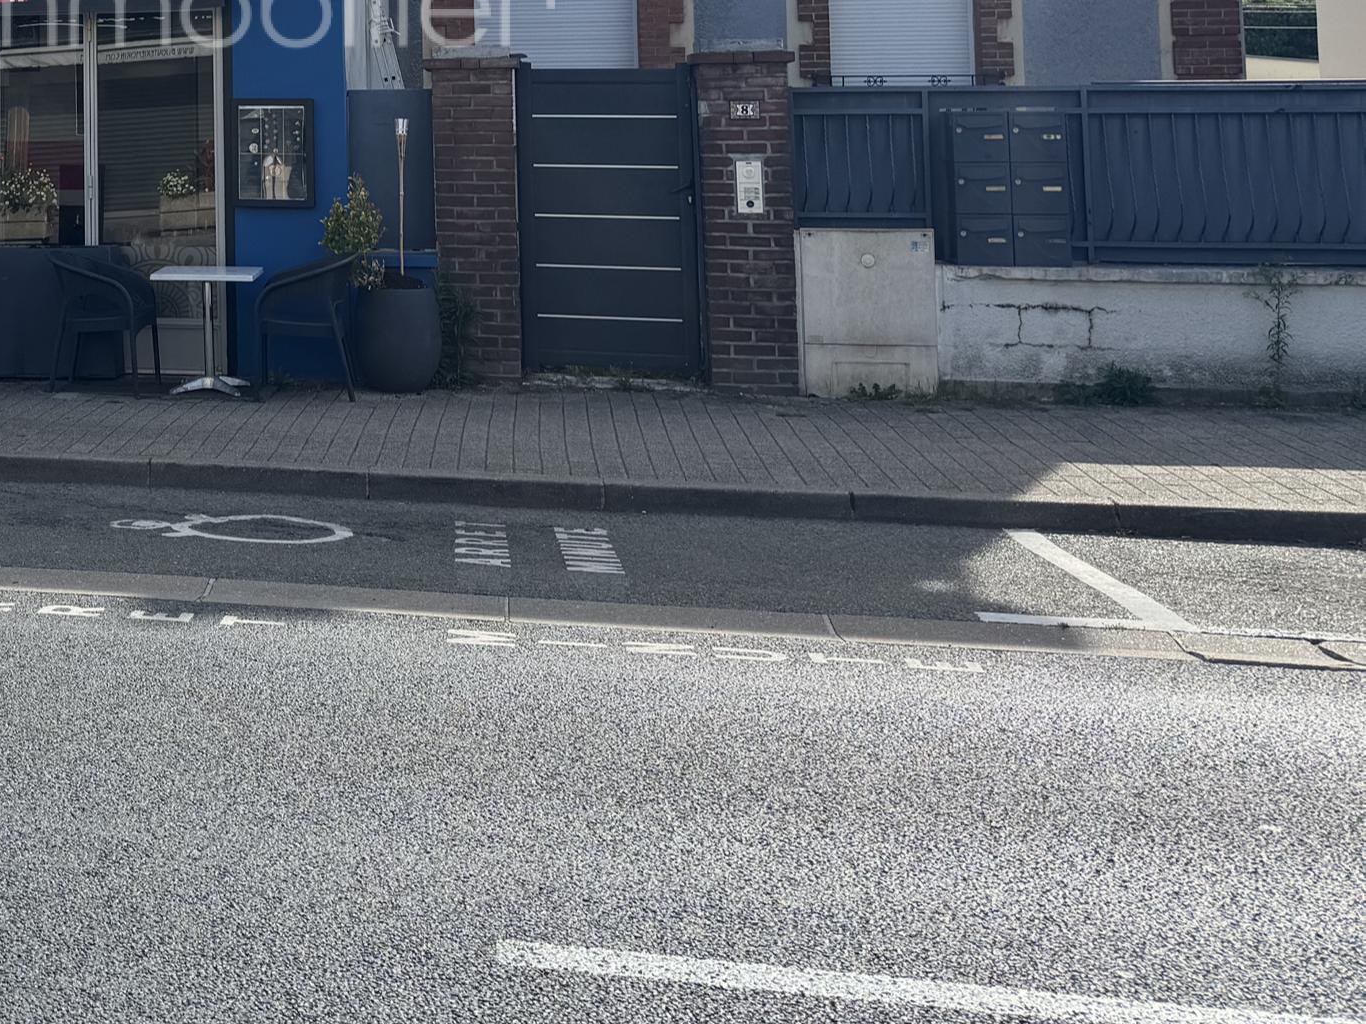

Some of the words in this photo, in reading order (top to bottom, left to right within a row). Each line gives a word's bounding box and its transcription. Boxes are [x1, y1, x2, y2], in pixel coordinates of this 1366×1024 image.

[454, 521, 511, 568] ARRET
[553, 527, 626, 575] MINUTE
[446, 628, 984, 673] MINUTE
